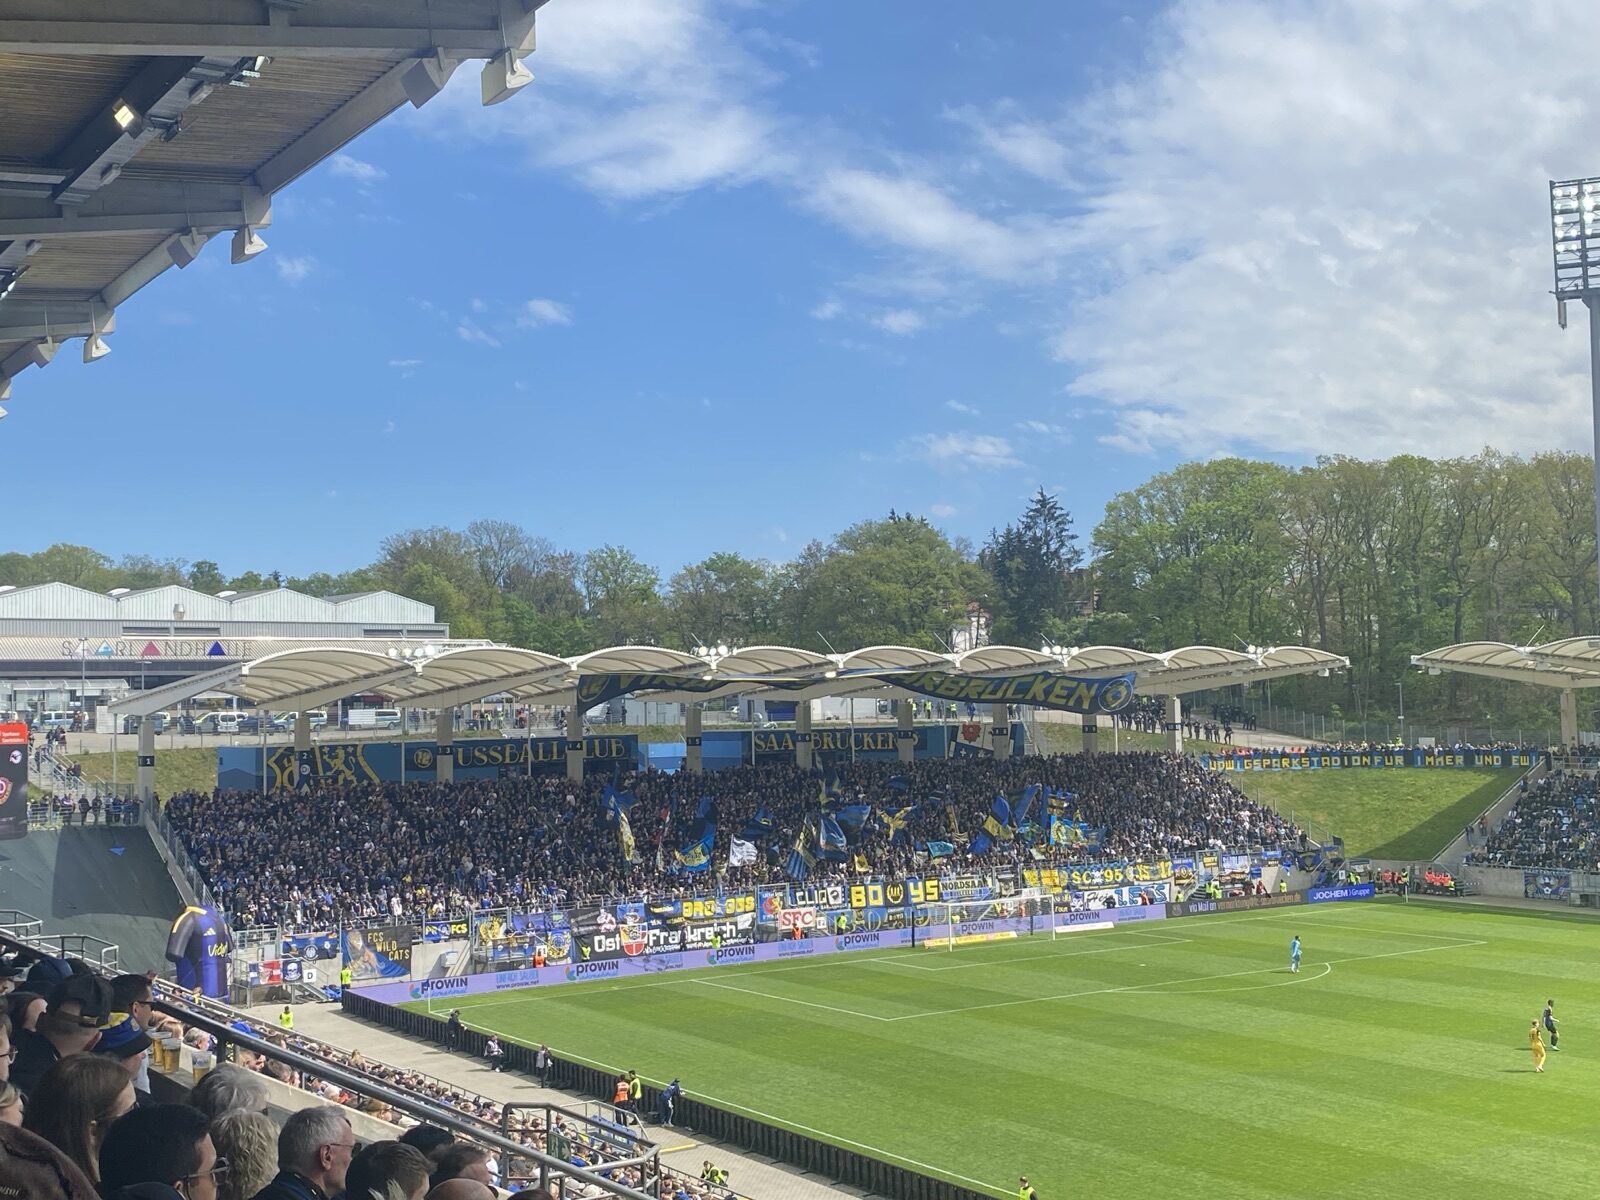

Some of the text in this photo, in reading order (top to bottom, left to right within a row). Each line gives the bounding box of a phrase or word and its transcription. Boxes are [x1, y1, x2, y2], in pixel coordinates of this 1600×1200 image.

[1475, 755, 1501, 765] UND
[1313, 887, 1370, 900] JOCHEM Gruppe
[782, 911, 813, 926] SFC
[451, 923, 468, 934] FCS
[368, 932, 384, 943] FCS
[377, 940, 397, 952] WILD
[388, 949, 410, 961] CATS
[307, 972, 314, 980] D
